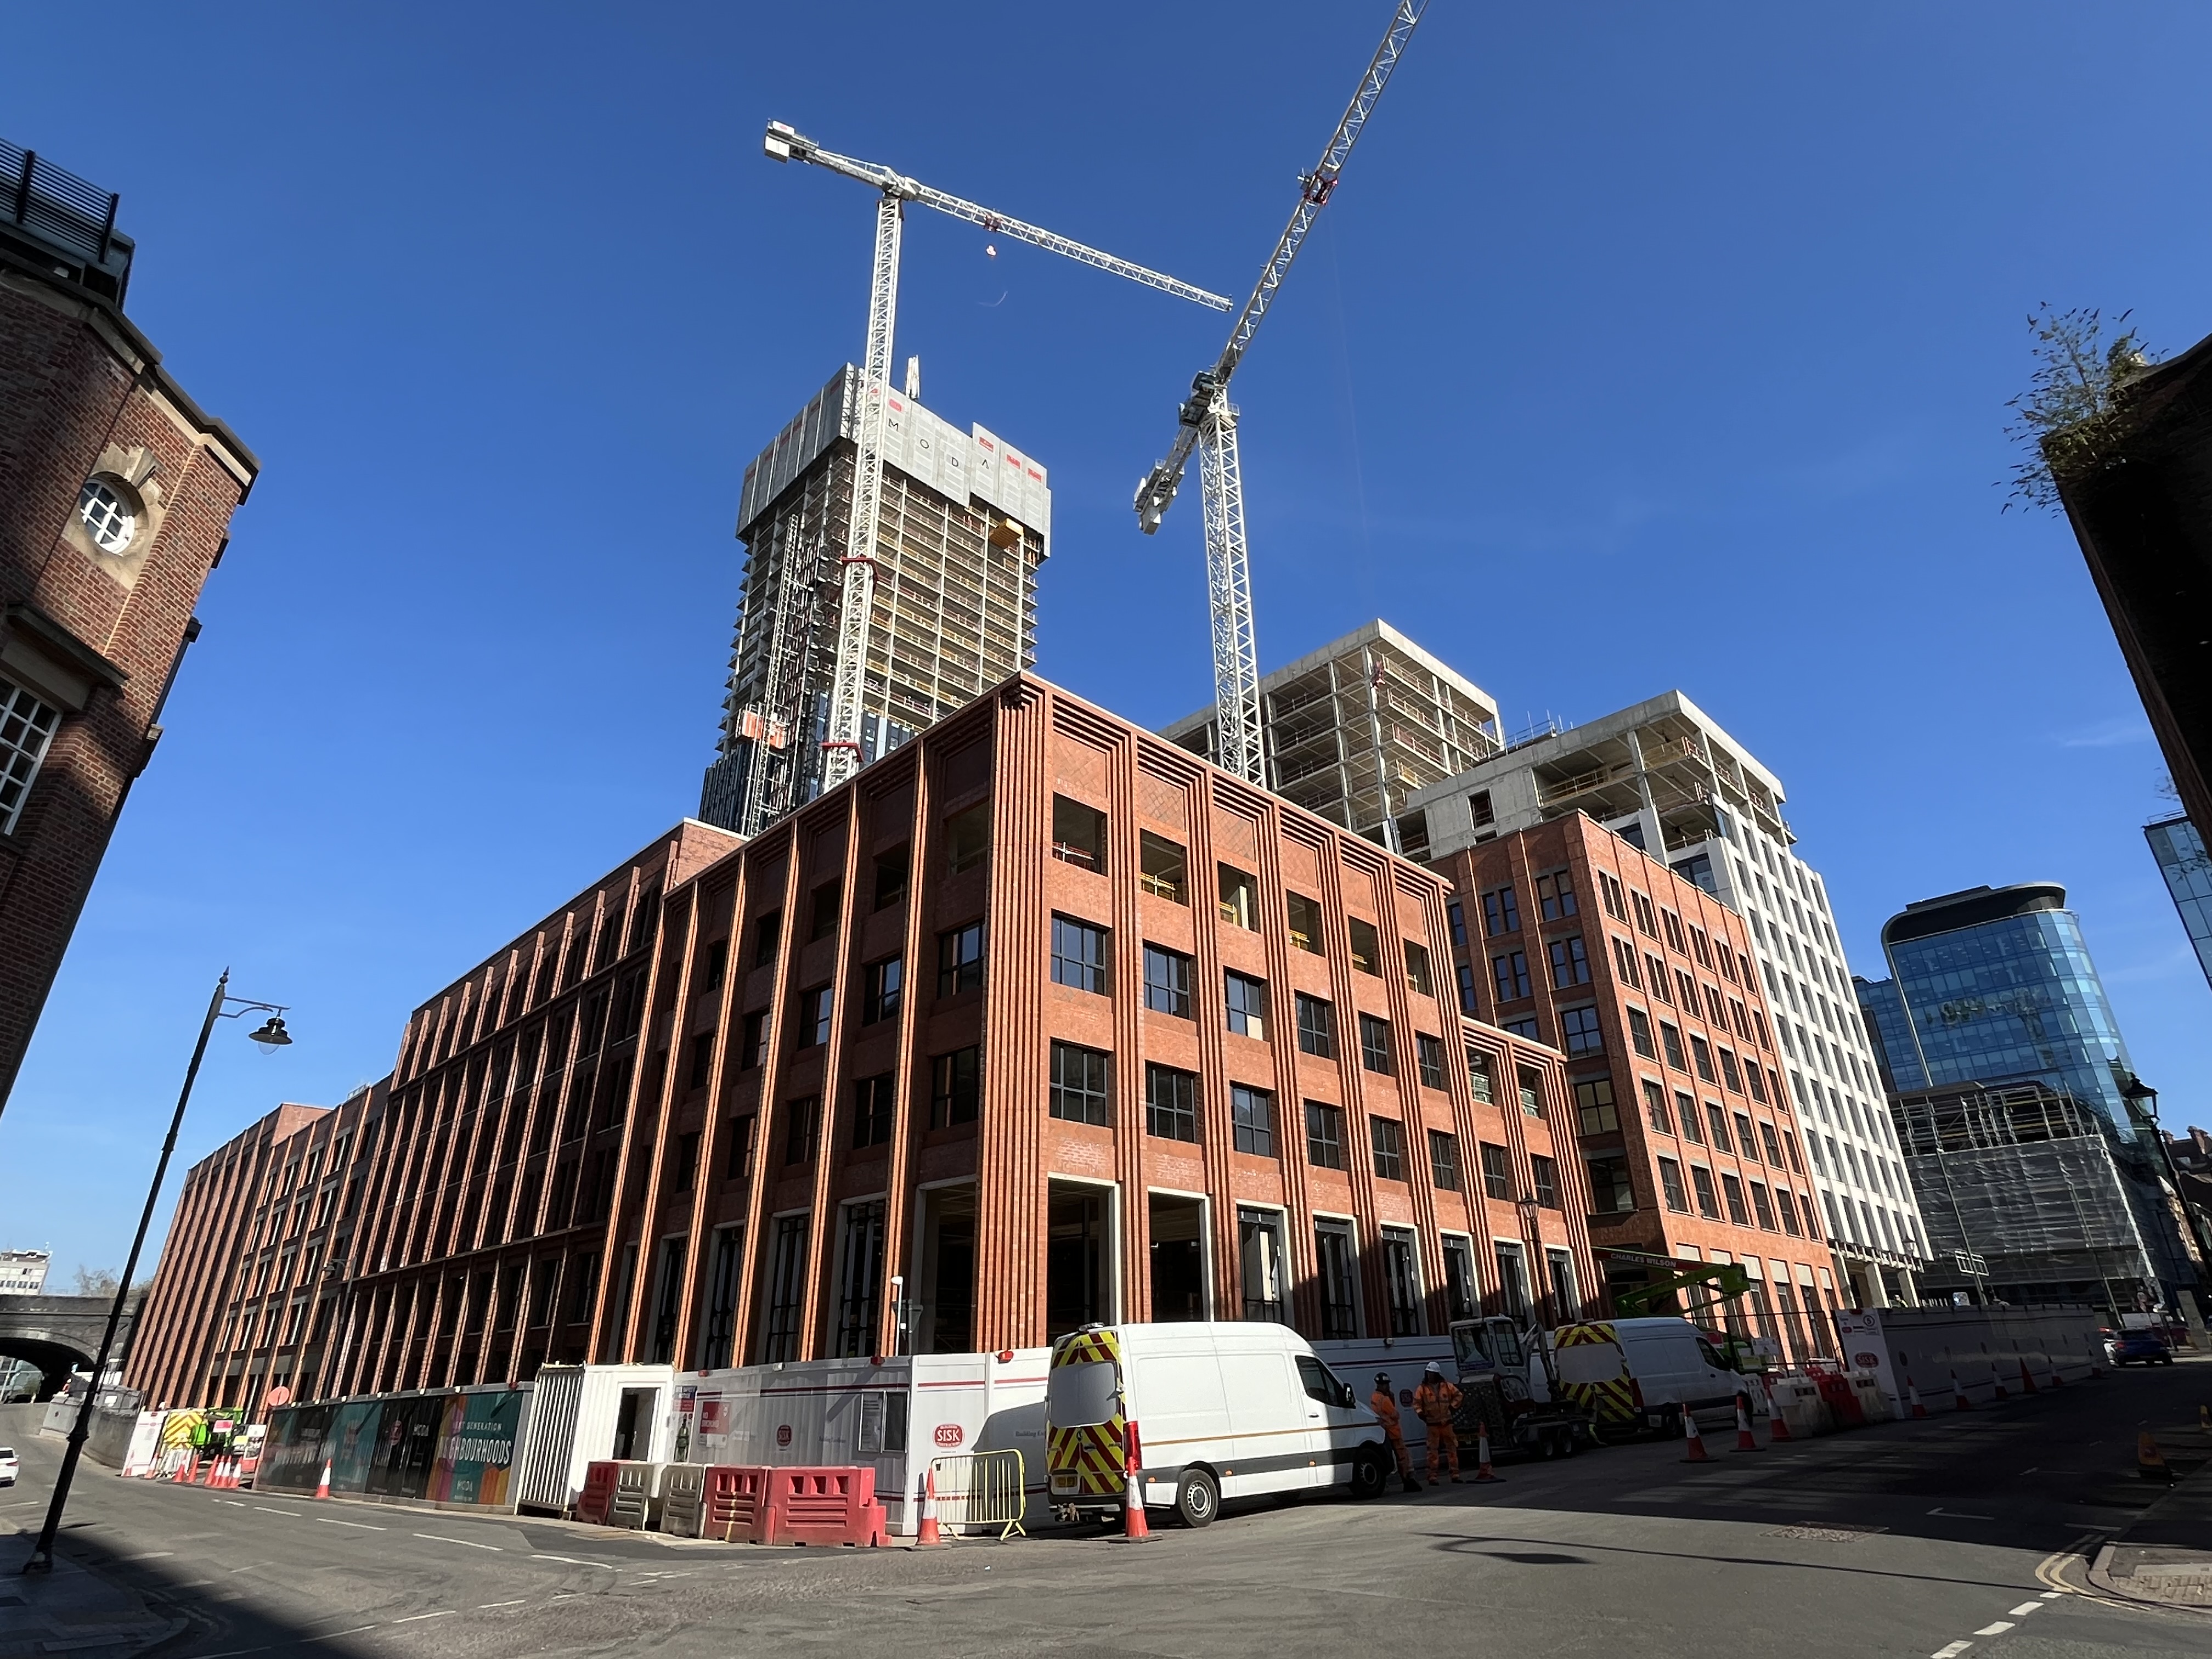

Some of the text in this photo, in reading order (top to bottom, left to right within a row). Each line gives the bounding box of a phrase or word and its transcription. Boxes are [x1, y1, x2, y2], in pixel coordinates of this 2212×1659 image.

[1611, 1252, 1677, 1268] CHARLES WILSON
[937, 1429, 960, 1442] SISK
